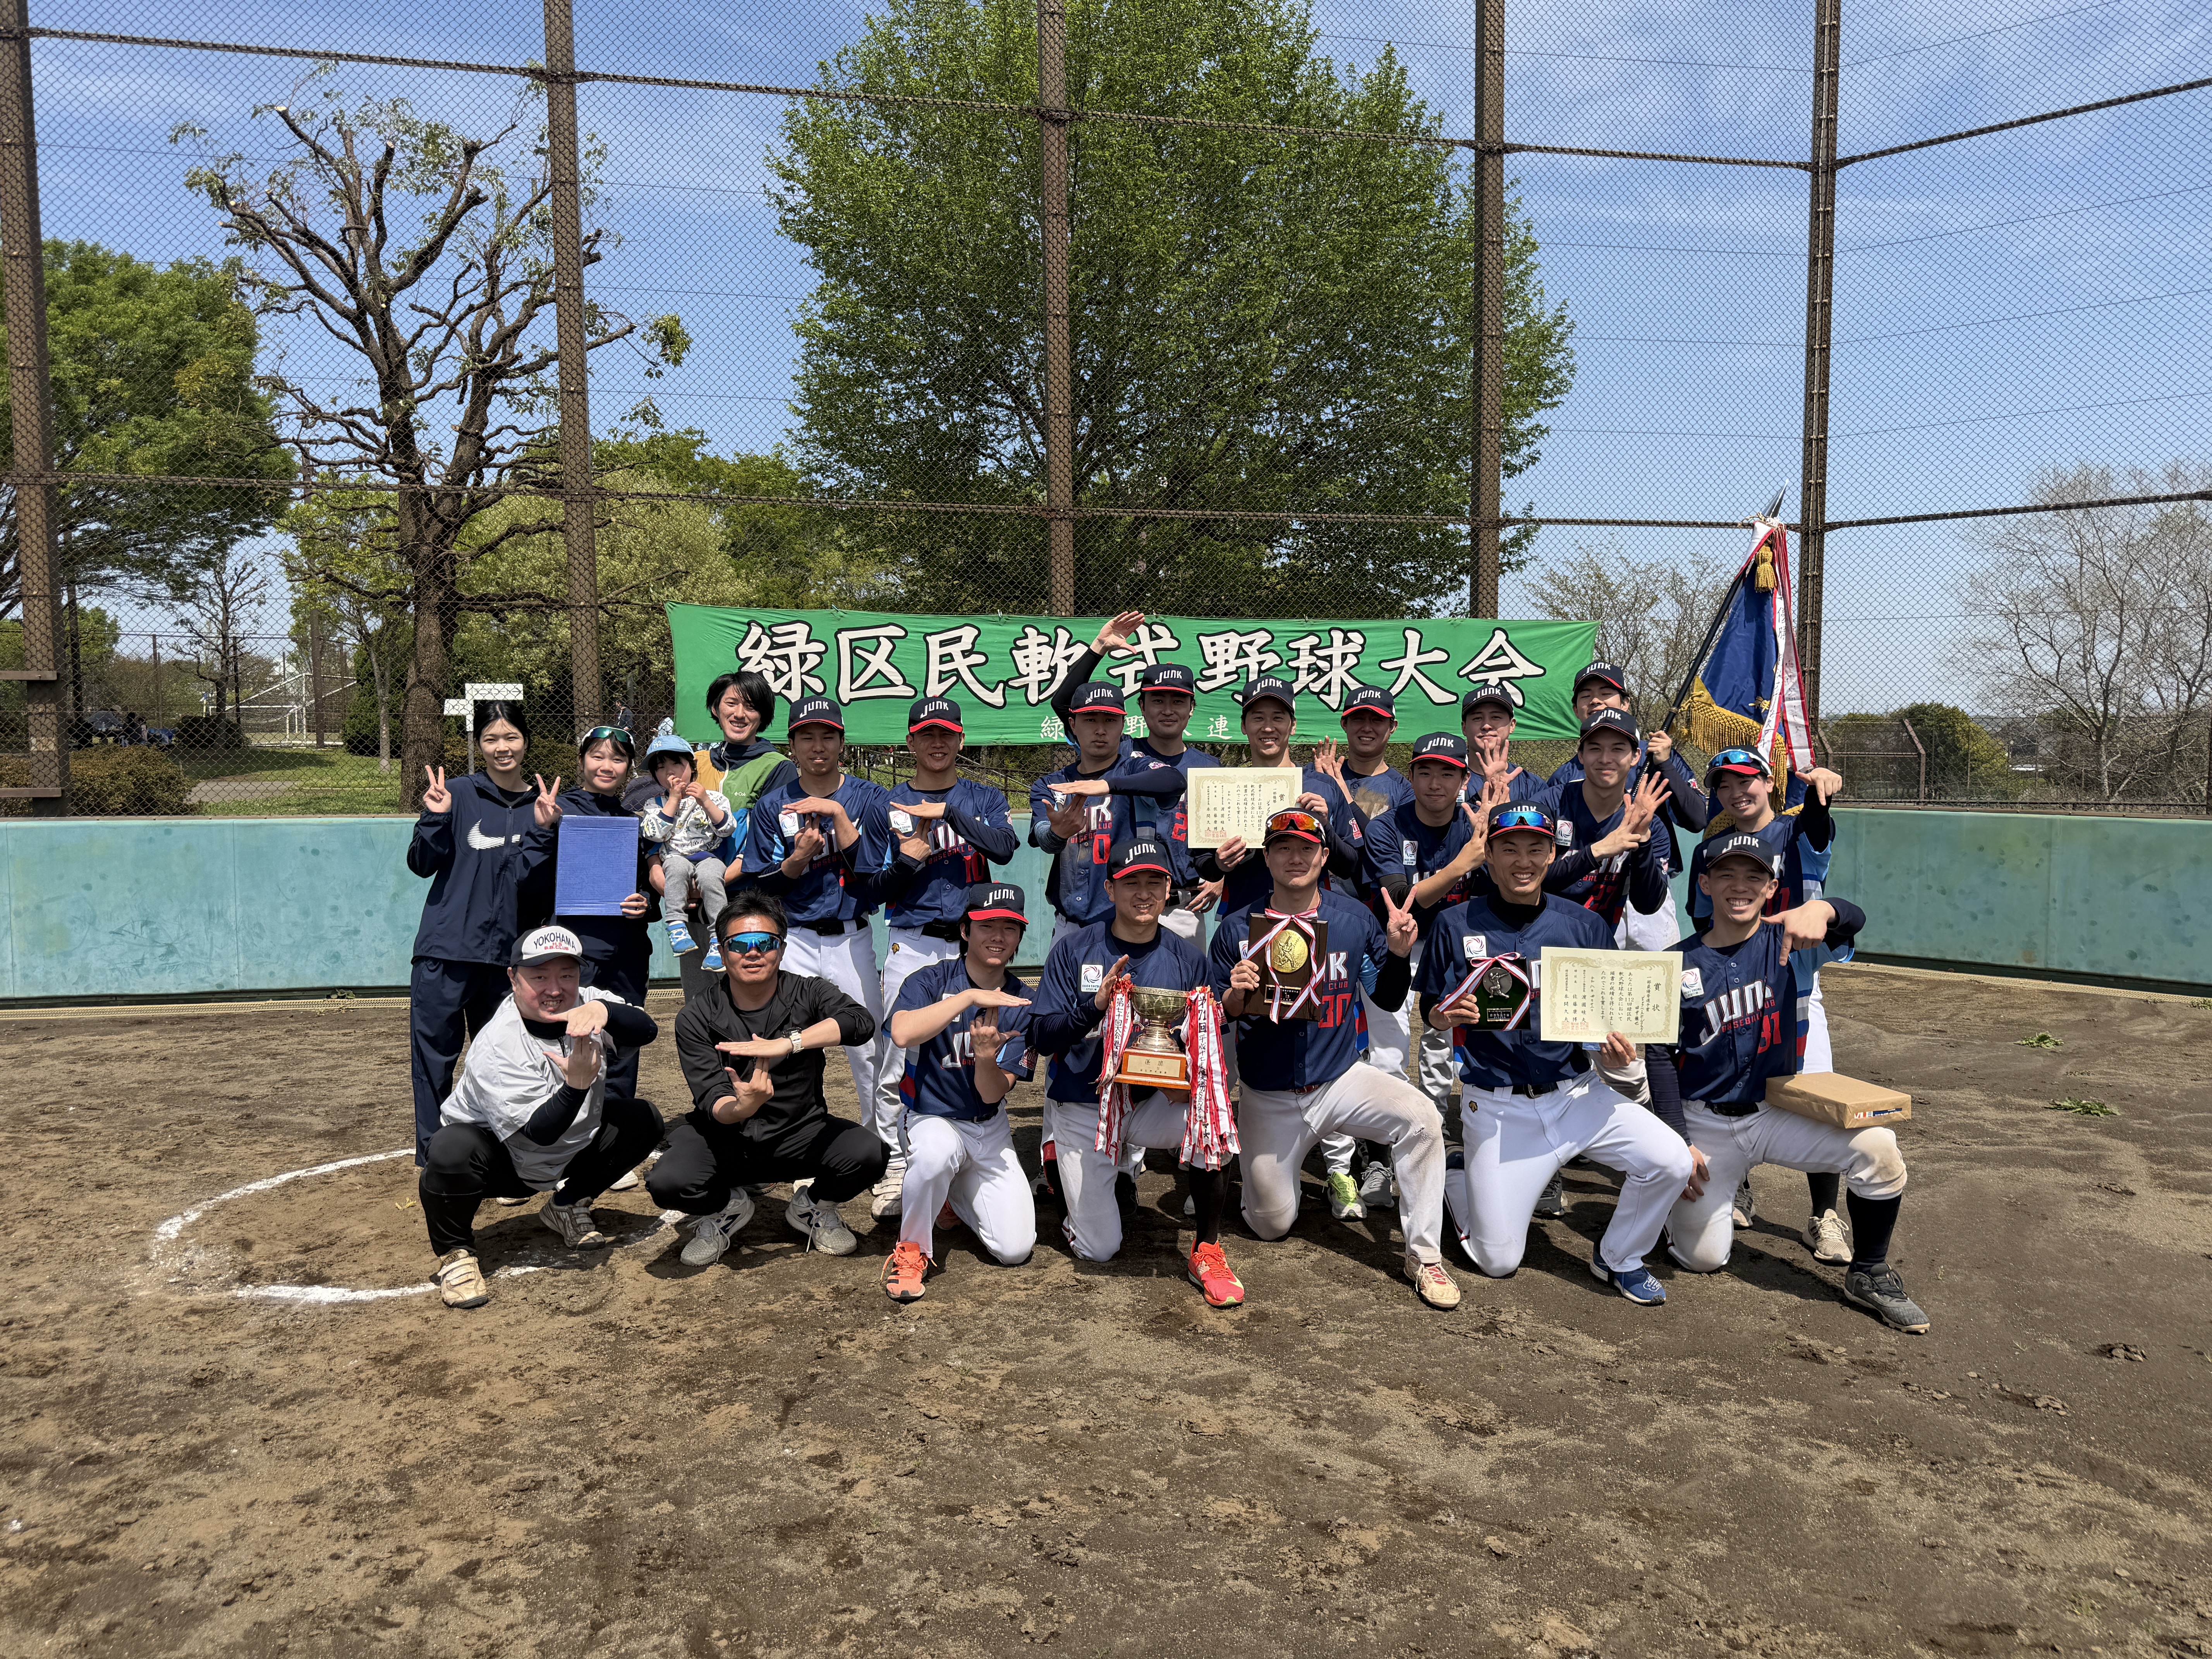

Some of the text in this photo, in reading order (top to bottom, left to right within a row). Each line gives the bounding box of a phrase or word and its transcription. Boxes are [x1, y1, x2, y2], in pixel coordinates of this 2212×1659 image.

[1155, 670, 1182, 684] JUNK
[1253, 679, 1282, 696] JUNK
[1085, 689, 1113, 704] JUNK
[1353, 691, 1381, 705] JUNK
[800, 701, 829, 718] JUNK
[920, 701, 948, 719] JUNK
[1591, 710, 1621, 726] JUNK
[1422, 738, 1453, 752] JUNK
[1722, 836, 1759, 853] JUNK
[1125, 844, 1156, 865] JUNK
[984, 889, 1015, 907] JUNK
[534, 932, 577, 951] YOKOHAMA
